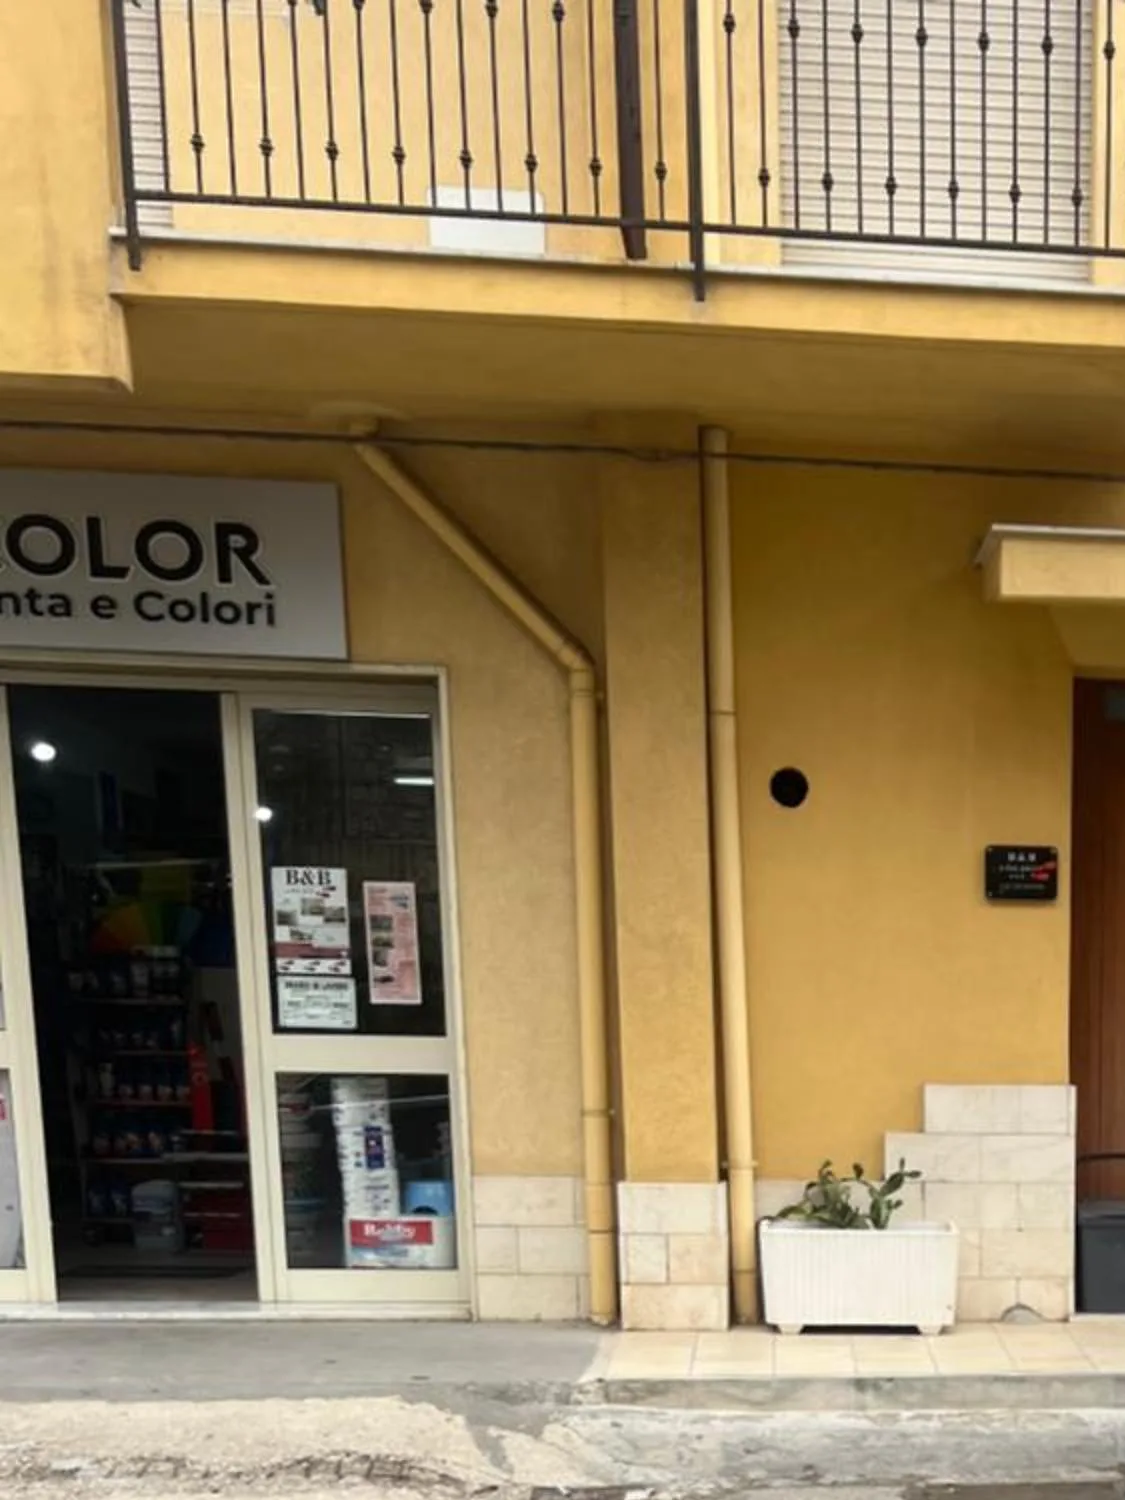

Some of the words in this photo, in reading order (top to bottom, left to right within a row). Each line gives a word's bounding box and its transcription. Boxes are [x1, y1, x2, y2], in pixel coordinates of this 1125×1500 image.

[5, 513, 271, 586] OLOR
[90, 594, 117, 620] e
[134, 590, 276, 627] Colori
